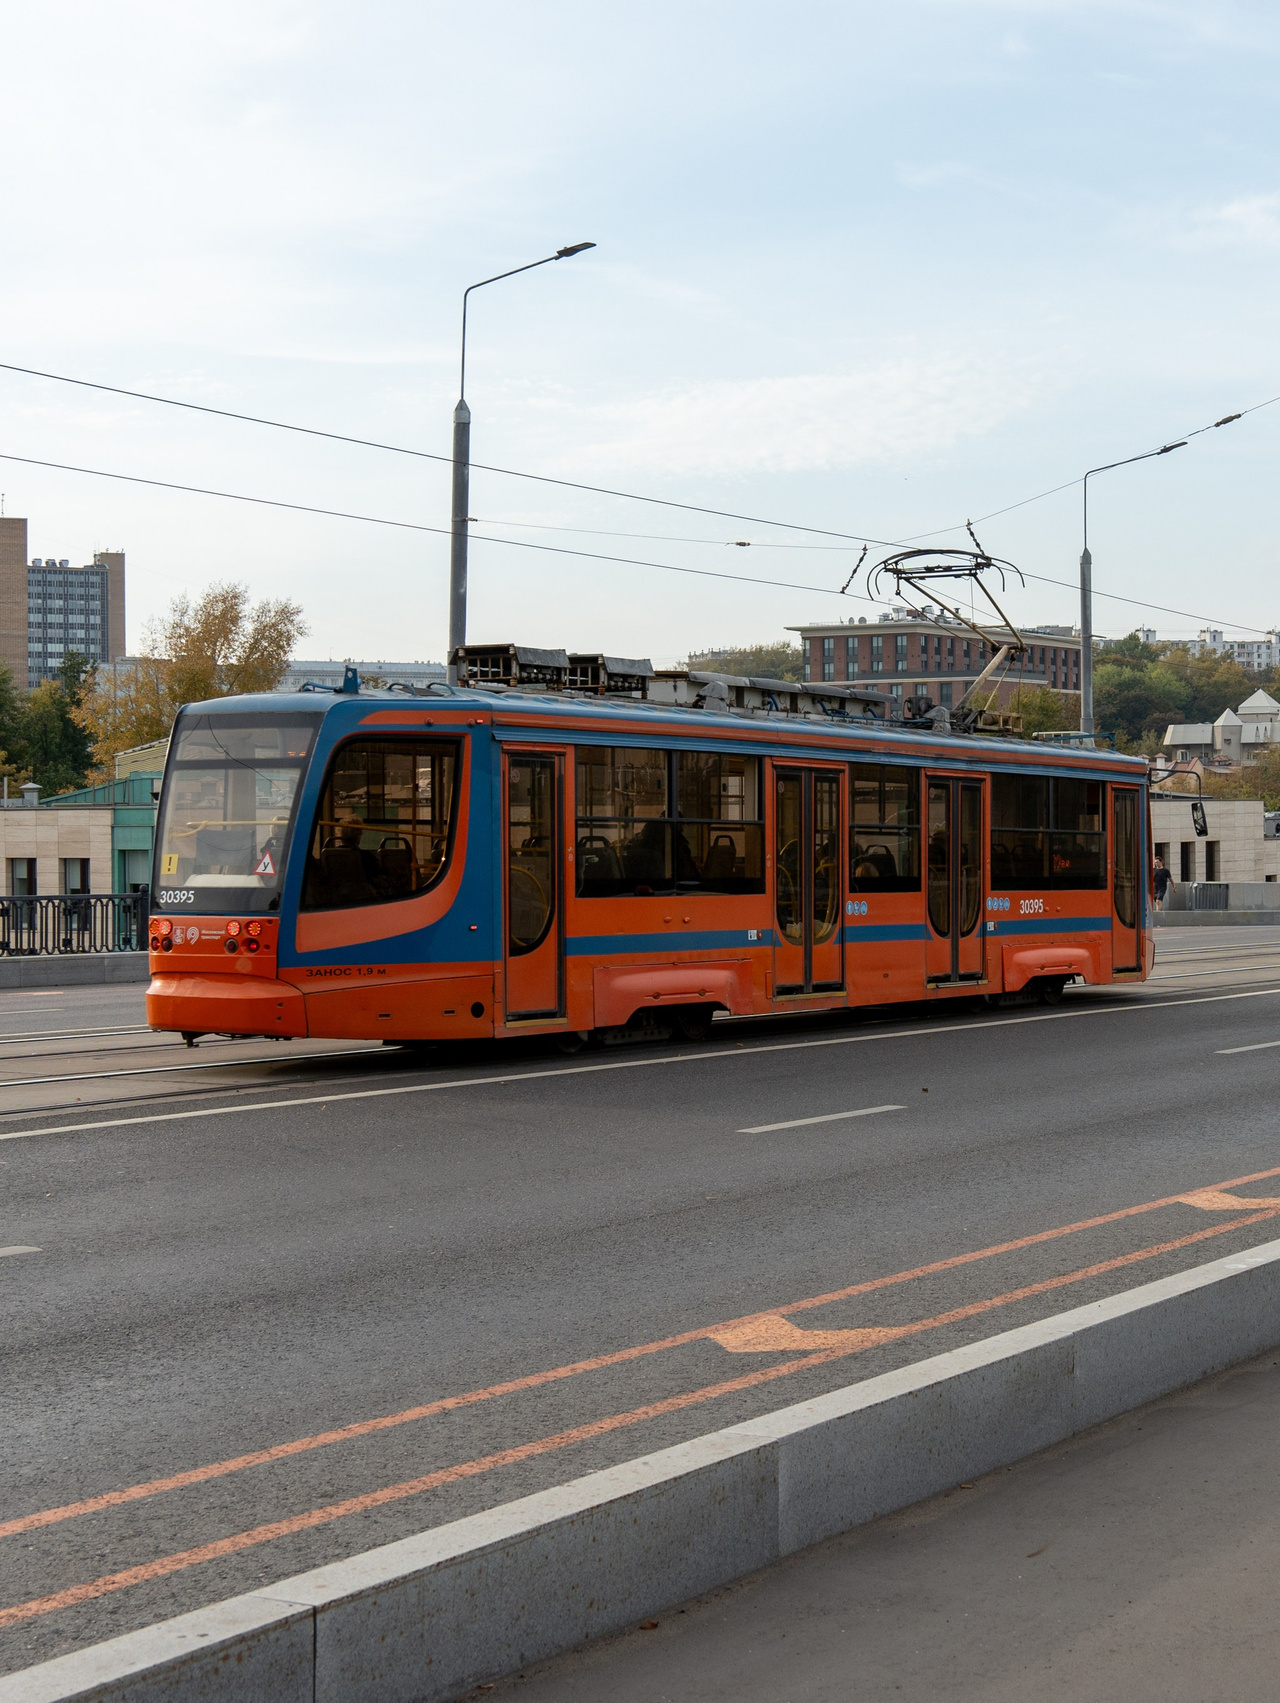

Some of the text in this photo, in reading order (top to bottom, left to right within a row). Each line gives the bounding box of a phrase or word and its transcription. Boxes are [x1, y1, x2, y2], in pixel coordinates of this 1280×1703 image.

[160, 890, 195, 904] 30395
[1020, 899, 1044, 914] 30395
[306, 968, 352, 977] ЗАНОС
[356, 967, 374, 976] 1,9
